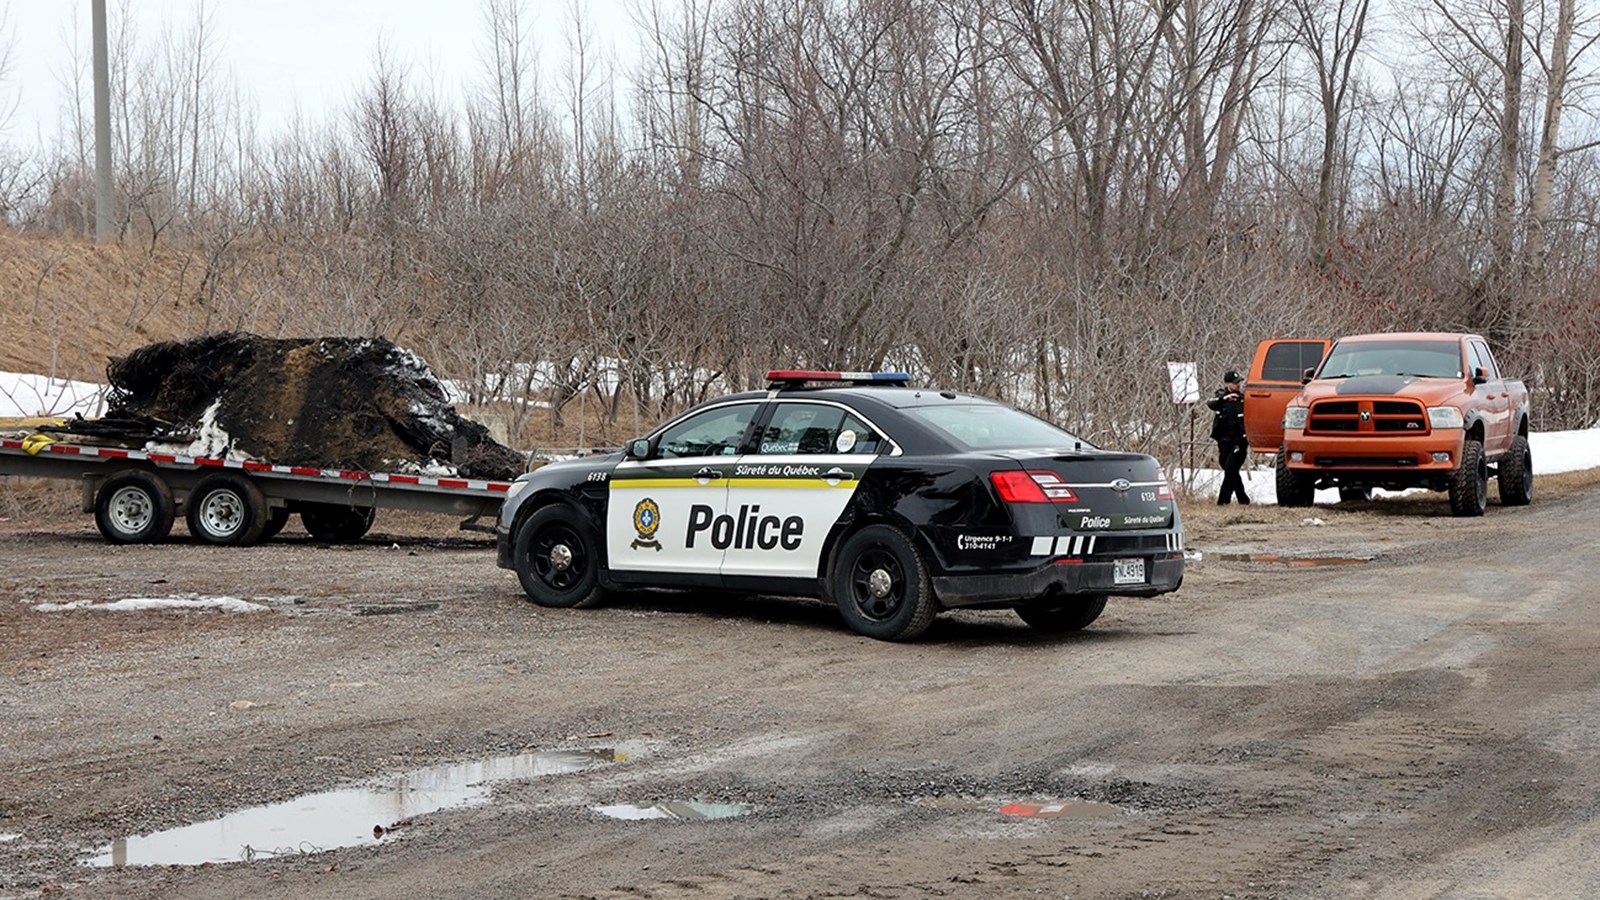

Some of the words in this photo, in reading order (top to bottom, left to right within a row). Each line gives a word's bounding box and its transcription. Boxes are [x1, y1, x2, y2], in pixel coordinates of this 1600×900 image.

[761, 442, 788, 453] Québec
[735, 464, 767, 476] Sûreté
[768, 466, 781, 475] du
[782, 465, 820, 476] Québec
[587, 471, 607, 481] 6138
[1141, 491, 1156, 502] 6138
[685, 504, 805, 550] Police
[1080, 516, 1111, 529] Police
[964, 535, 994, 544] Urgence
[995, 535, 1013, 543] 9-1-1
